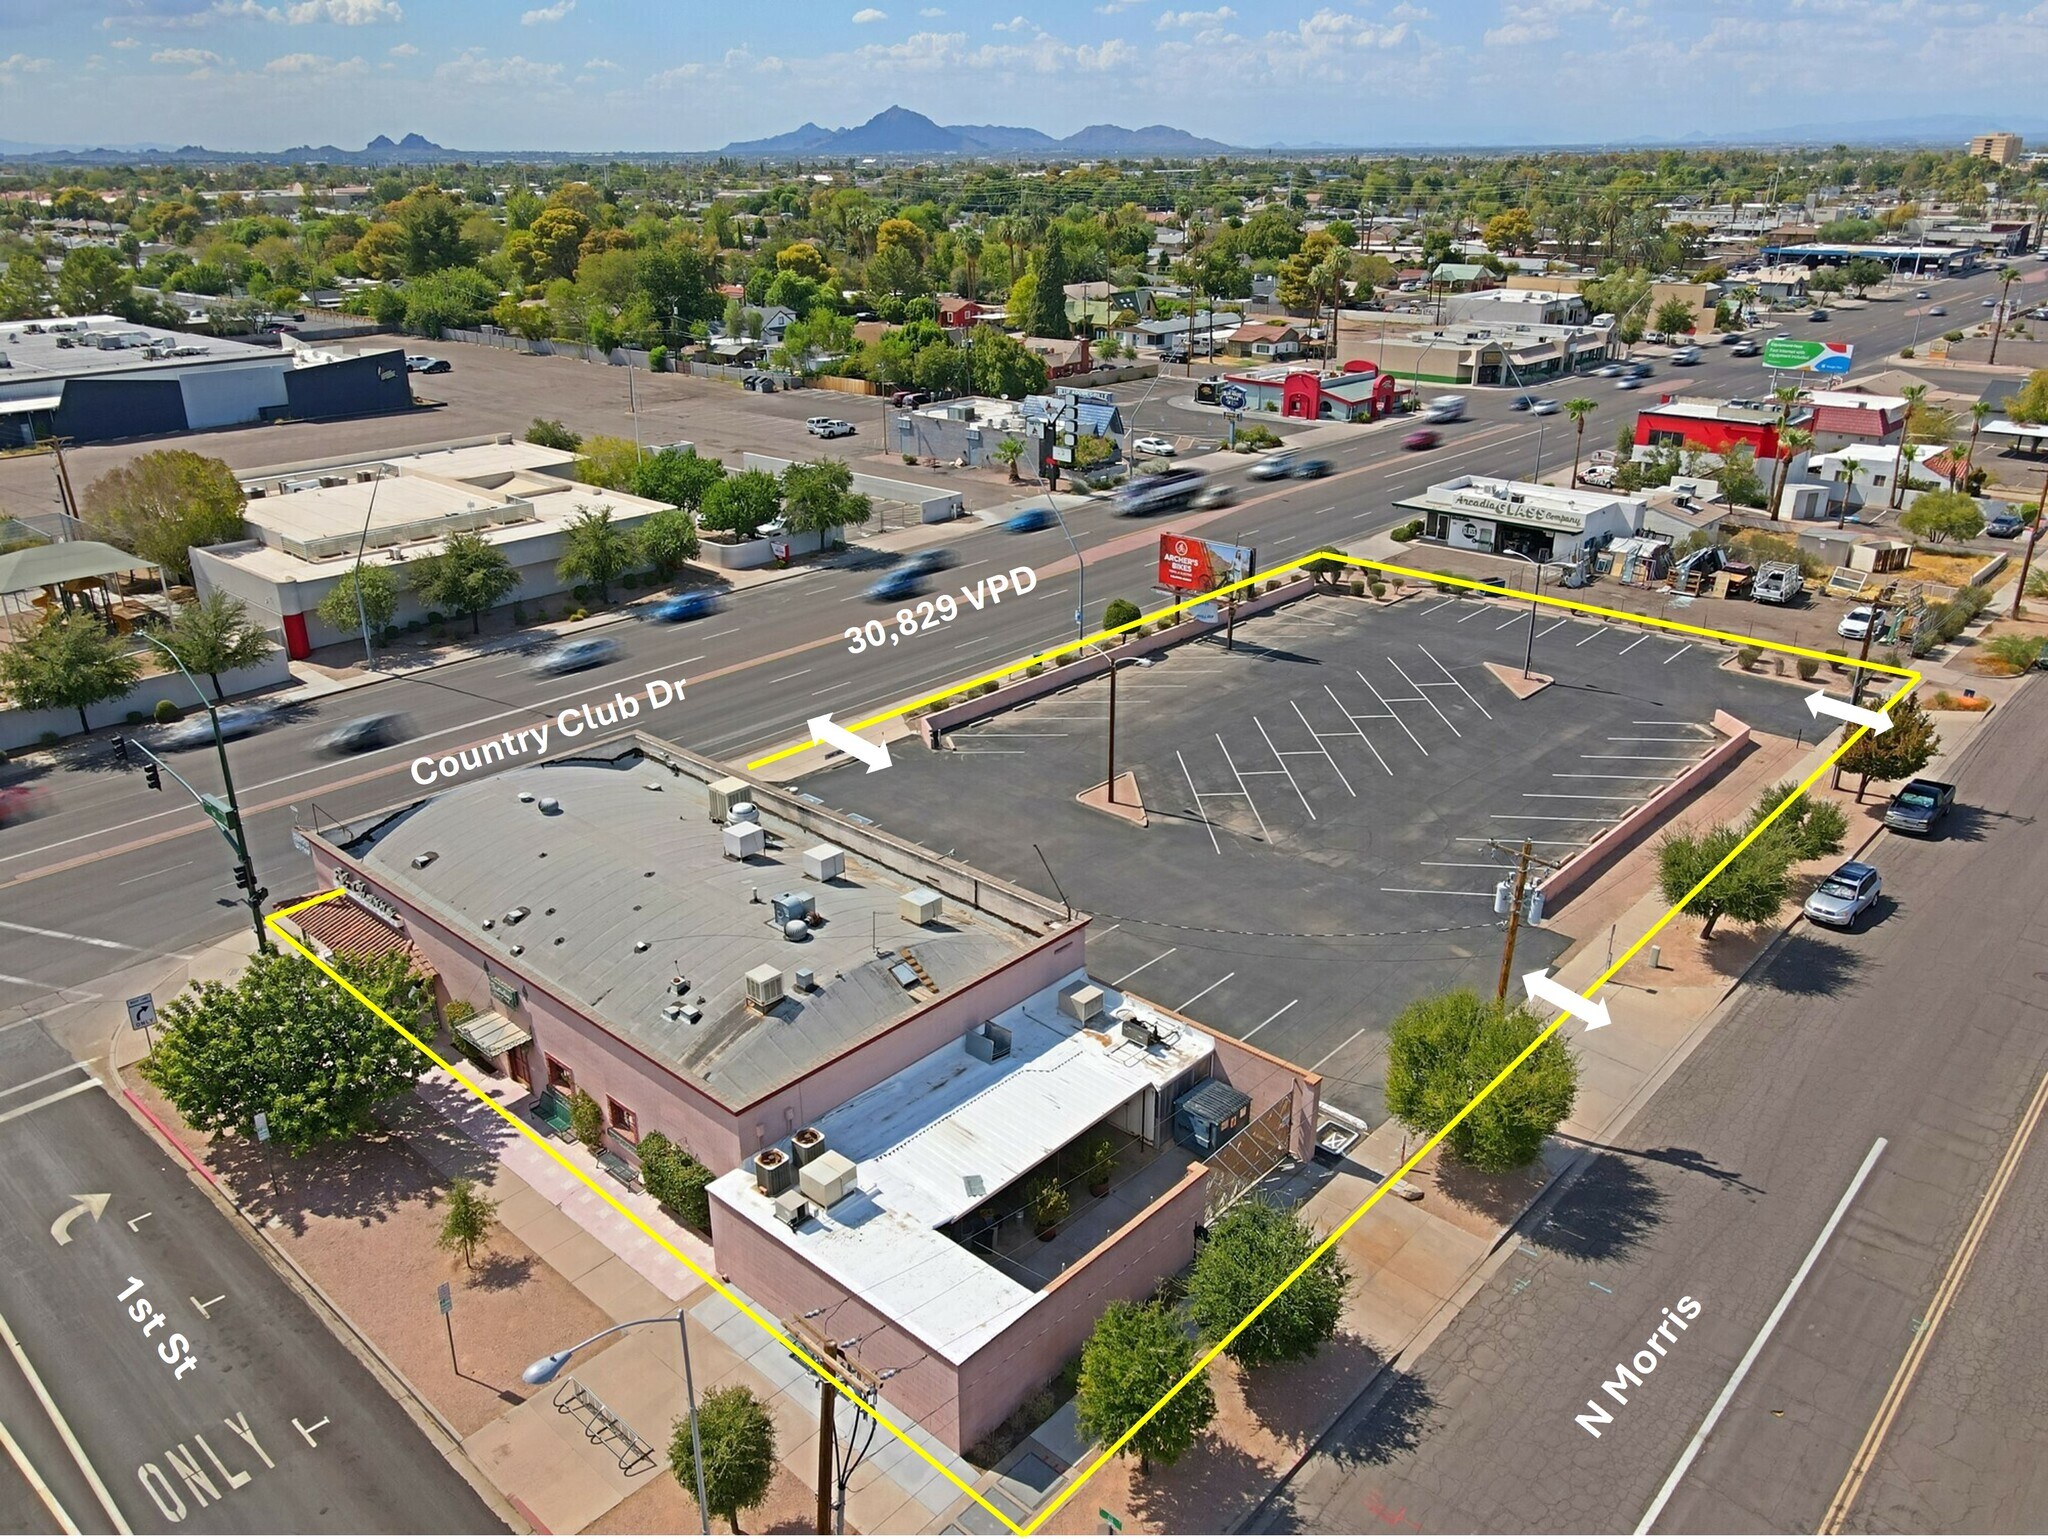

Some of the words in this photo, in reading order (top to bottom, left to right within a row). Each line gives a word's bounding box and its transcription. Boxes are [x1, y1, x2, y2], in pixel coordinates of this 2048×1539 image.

[1455, 494, 1495, 510] Arcadia
[1495, 502, 1546, 520] GLASS
[1545, 512, 1582, 526] Company
[1163, 553, 1199, 567] ARCHER'S
[1171, 562, 1193, 573] BIKES
[137, 1411, 276, 1523] ONLY
